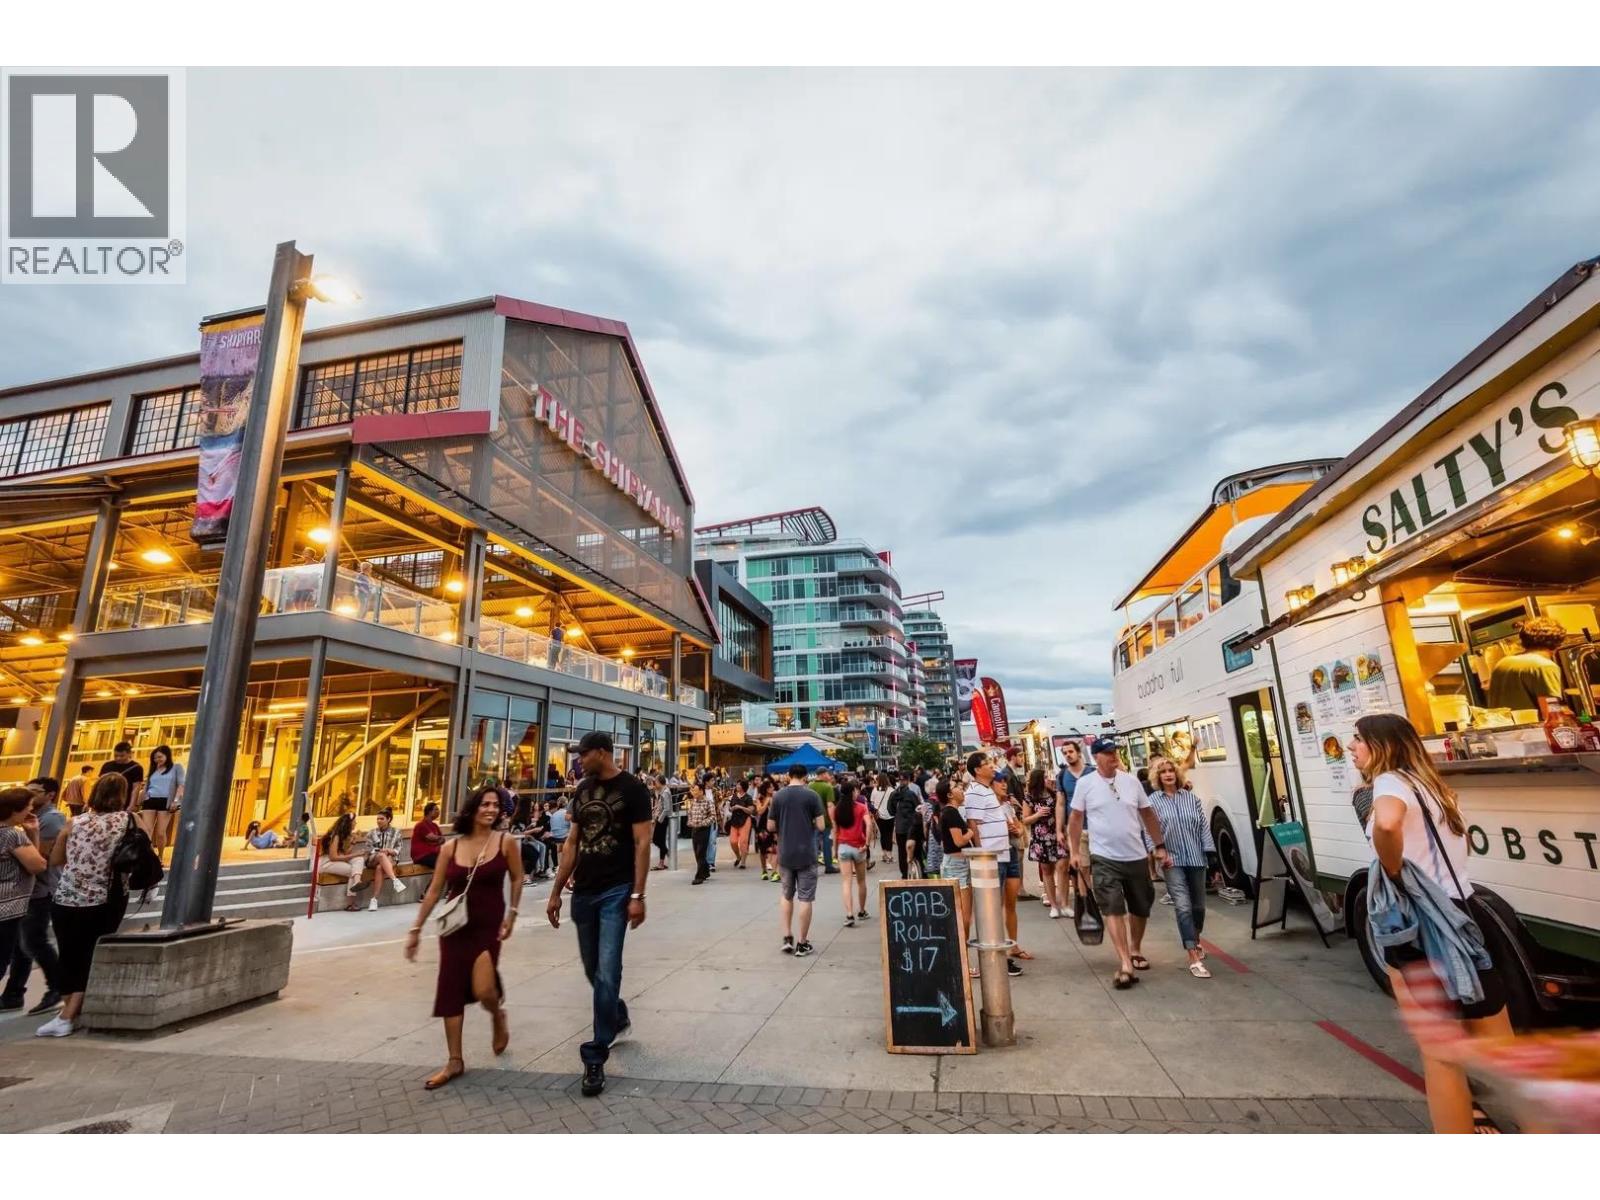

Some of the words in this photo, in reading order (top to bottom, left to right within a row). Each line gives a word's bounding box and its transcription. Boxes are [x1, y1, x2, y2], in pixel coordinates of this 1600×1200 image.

[220, 329, 262, 349] SHIPYAR
[535, 384, 585, 455] THE
[1362, 381, 1579, 555] SALTY'S
[1467, 824, 1600, 870] OBST
[888, 890, 948, 918] CRAB
[892, 920, 946, 944] ROLL
